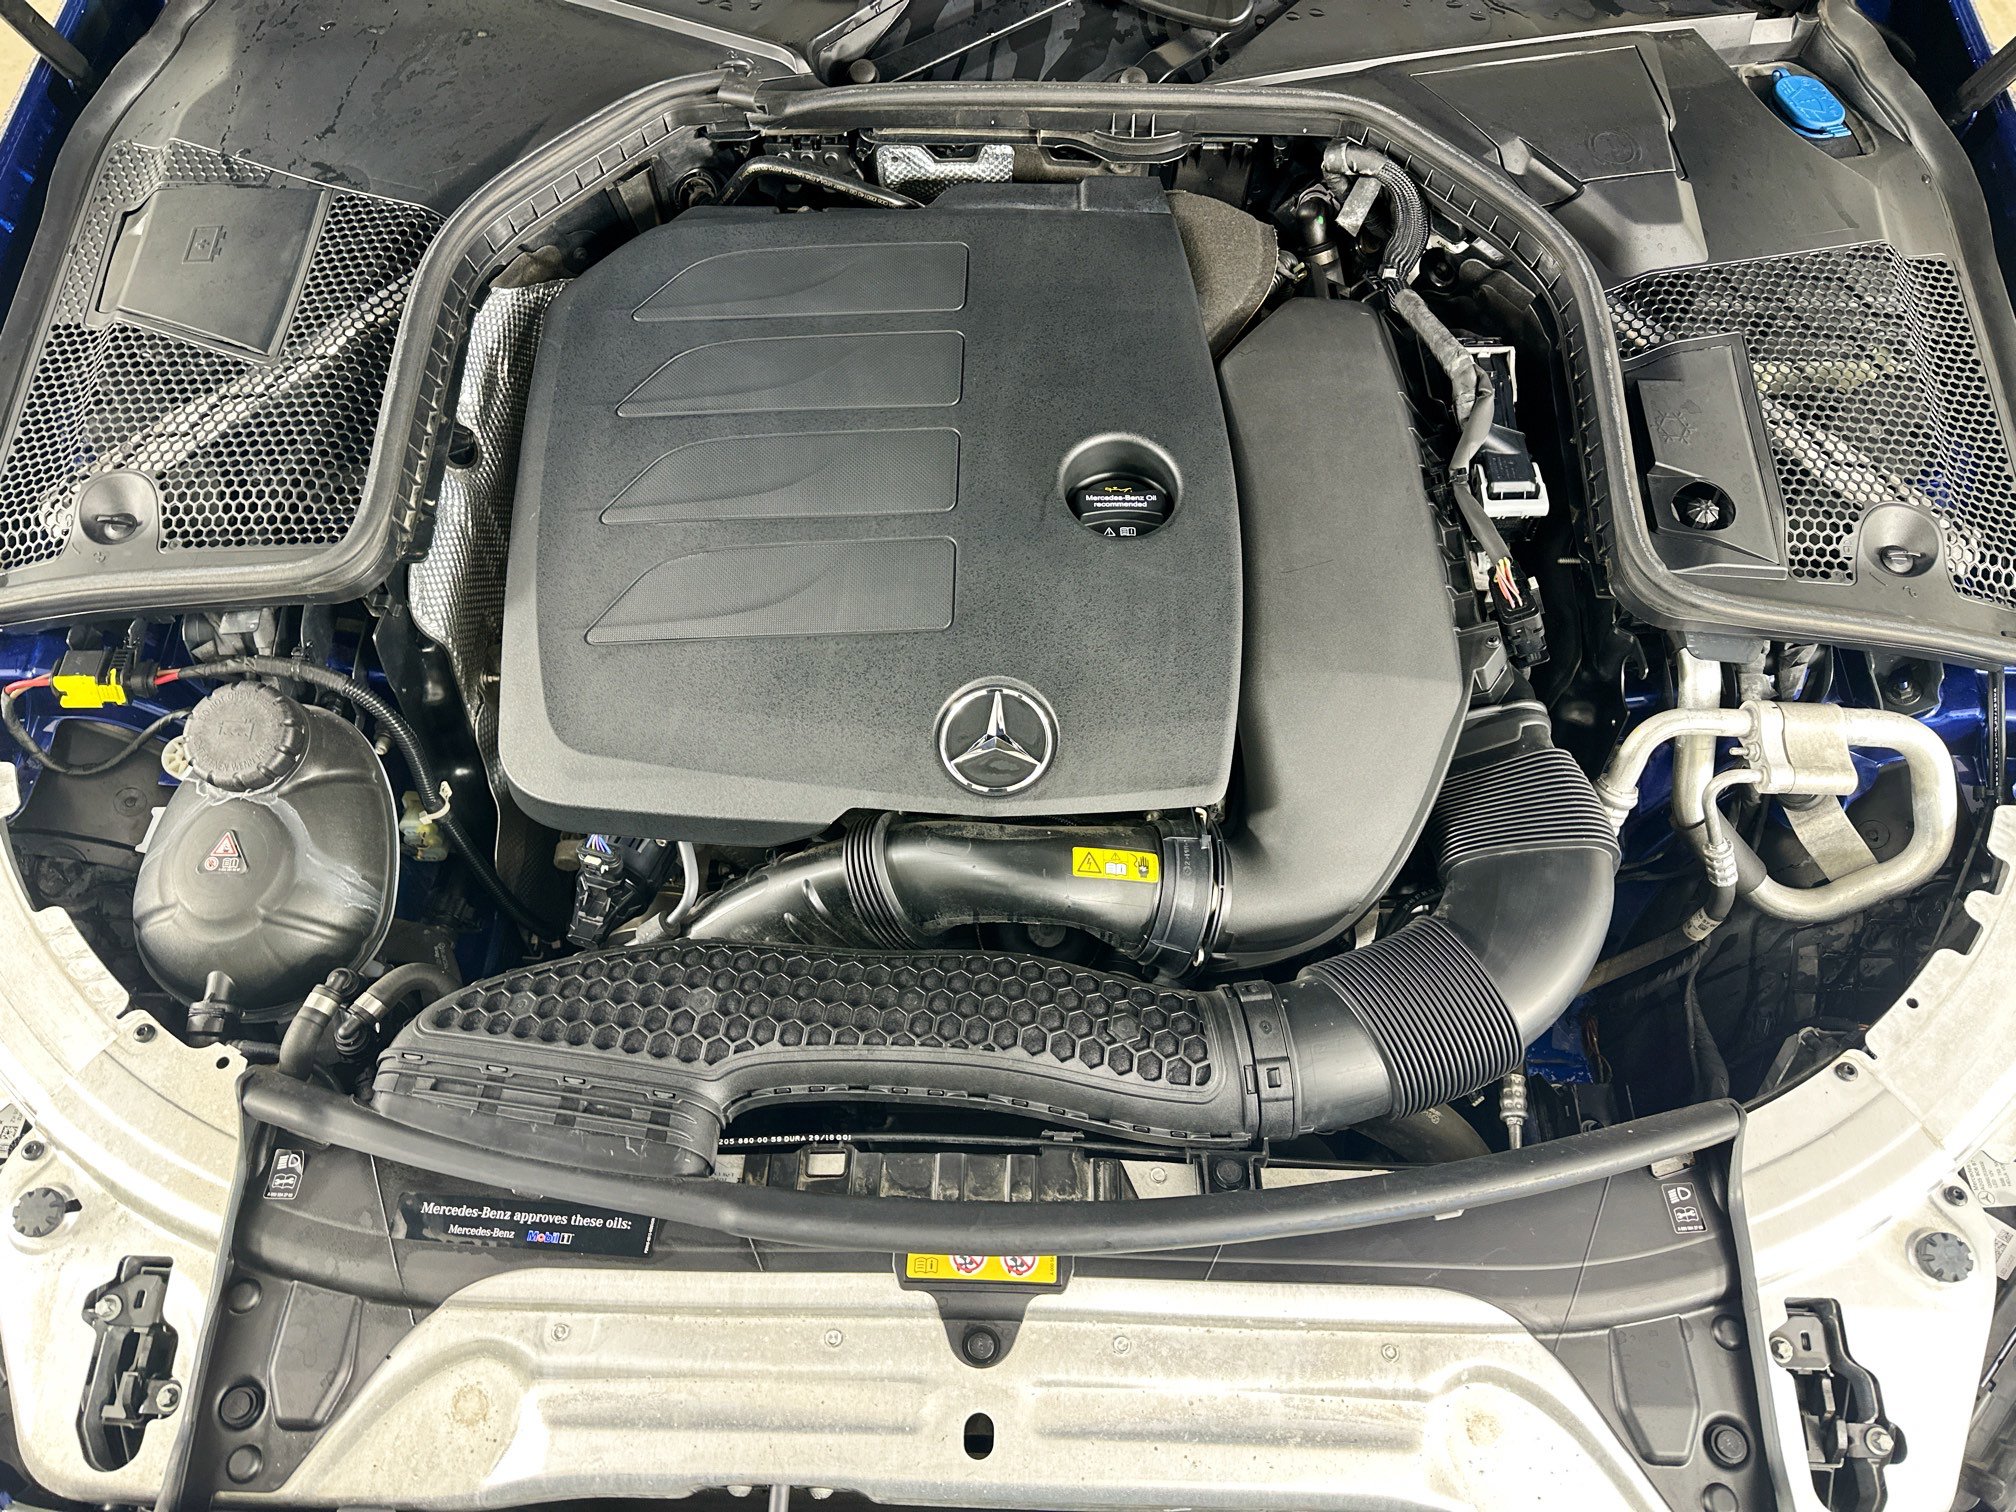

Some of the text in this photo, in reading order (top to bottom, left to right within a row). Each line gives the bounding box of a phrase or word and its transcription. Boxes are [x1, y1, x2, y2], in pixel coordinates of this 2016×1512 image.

[757, 1136, 768, 1144] 00
[420, 1201, 632, 1230] Mercedes-Benz approves these oils:
[448, 1223, 516, 1239] Mercedes-Benz
